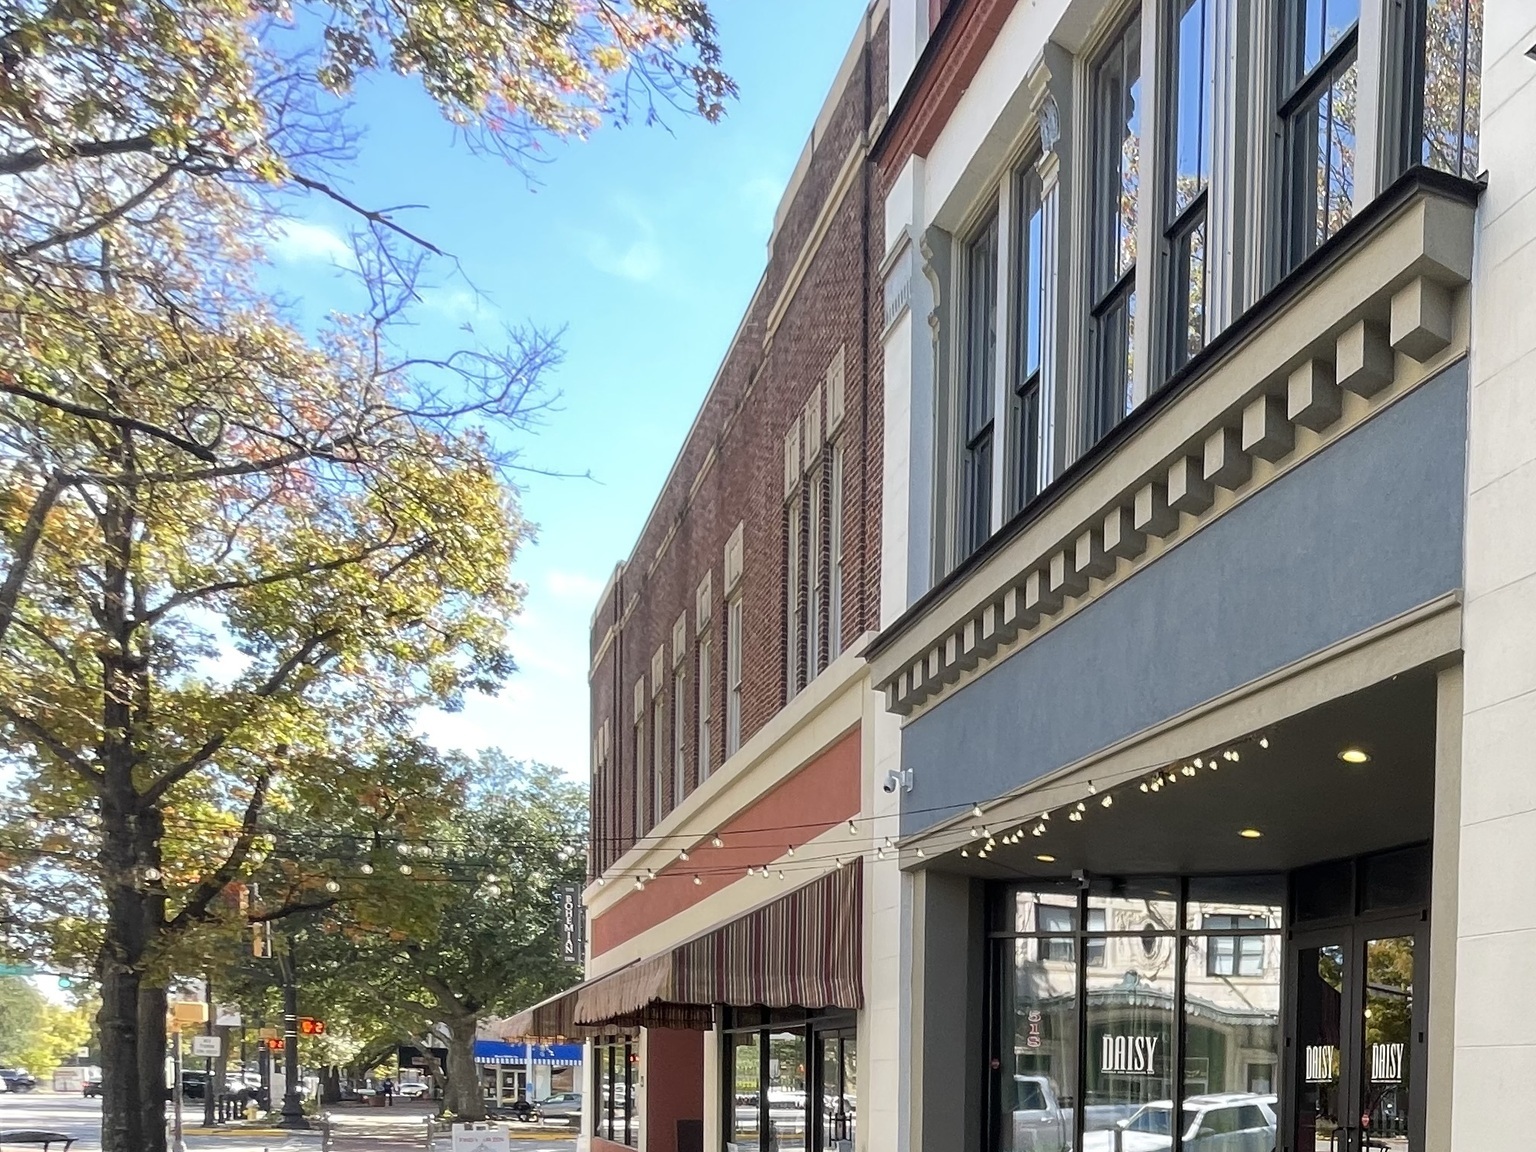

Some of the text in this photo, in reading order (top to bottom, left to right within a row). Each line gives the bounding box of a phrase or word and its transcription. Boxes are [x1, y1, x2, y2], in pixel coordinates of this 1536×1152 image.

[564, 895, 575, 954] BOHEMIAN
[1101, 1035, 1158, 1071] DAISY
[1306, 1045, 1334, 1079] DAISY
[1371, 1043, 1404, 1079] DAISY
